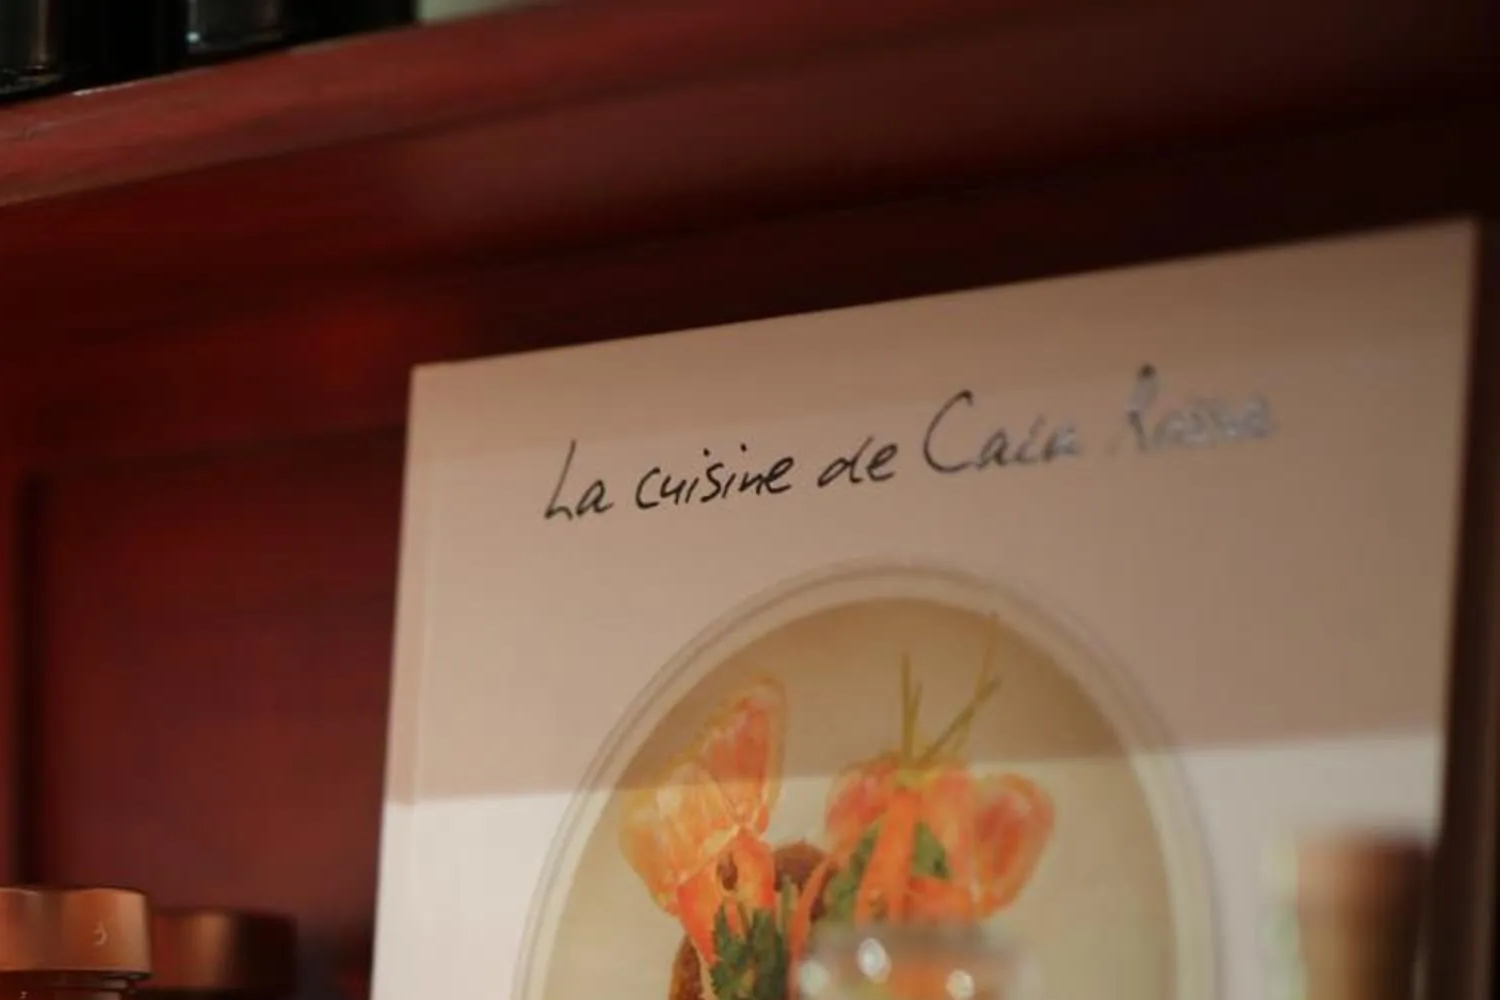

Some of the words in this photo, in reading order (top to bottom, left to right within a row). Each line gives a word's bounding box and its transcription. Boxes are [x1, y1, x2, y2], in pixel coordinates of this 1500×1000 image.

[544, 438, 613, 521] La
[635, 443, 795, 510] cuisine
[816, 436, 899, 489] de
